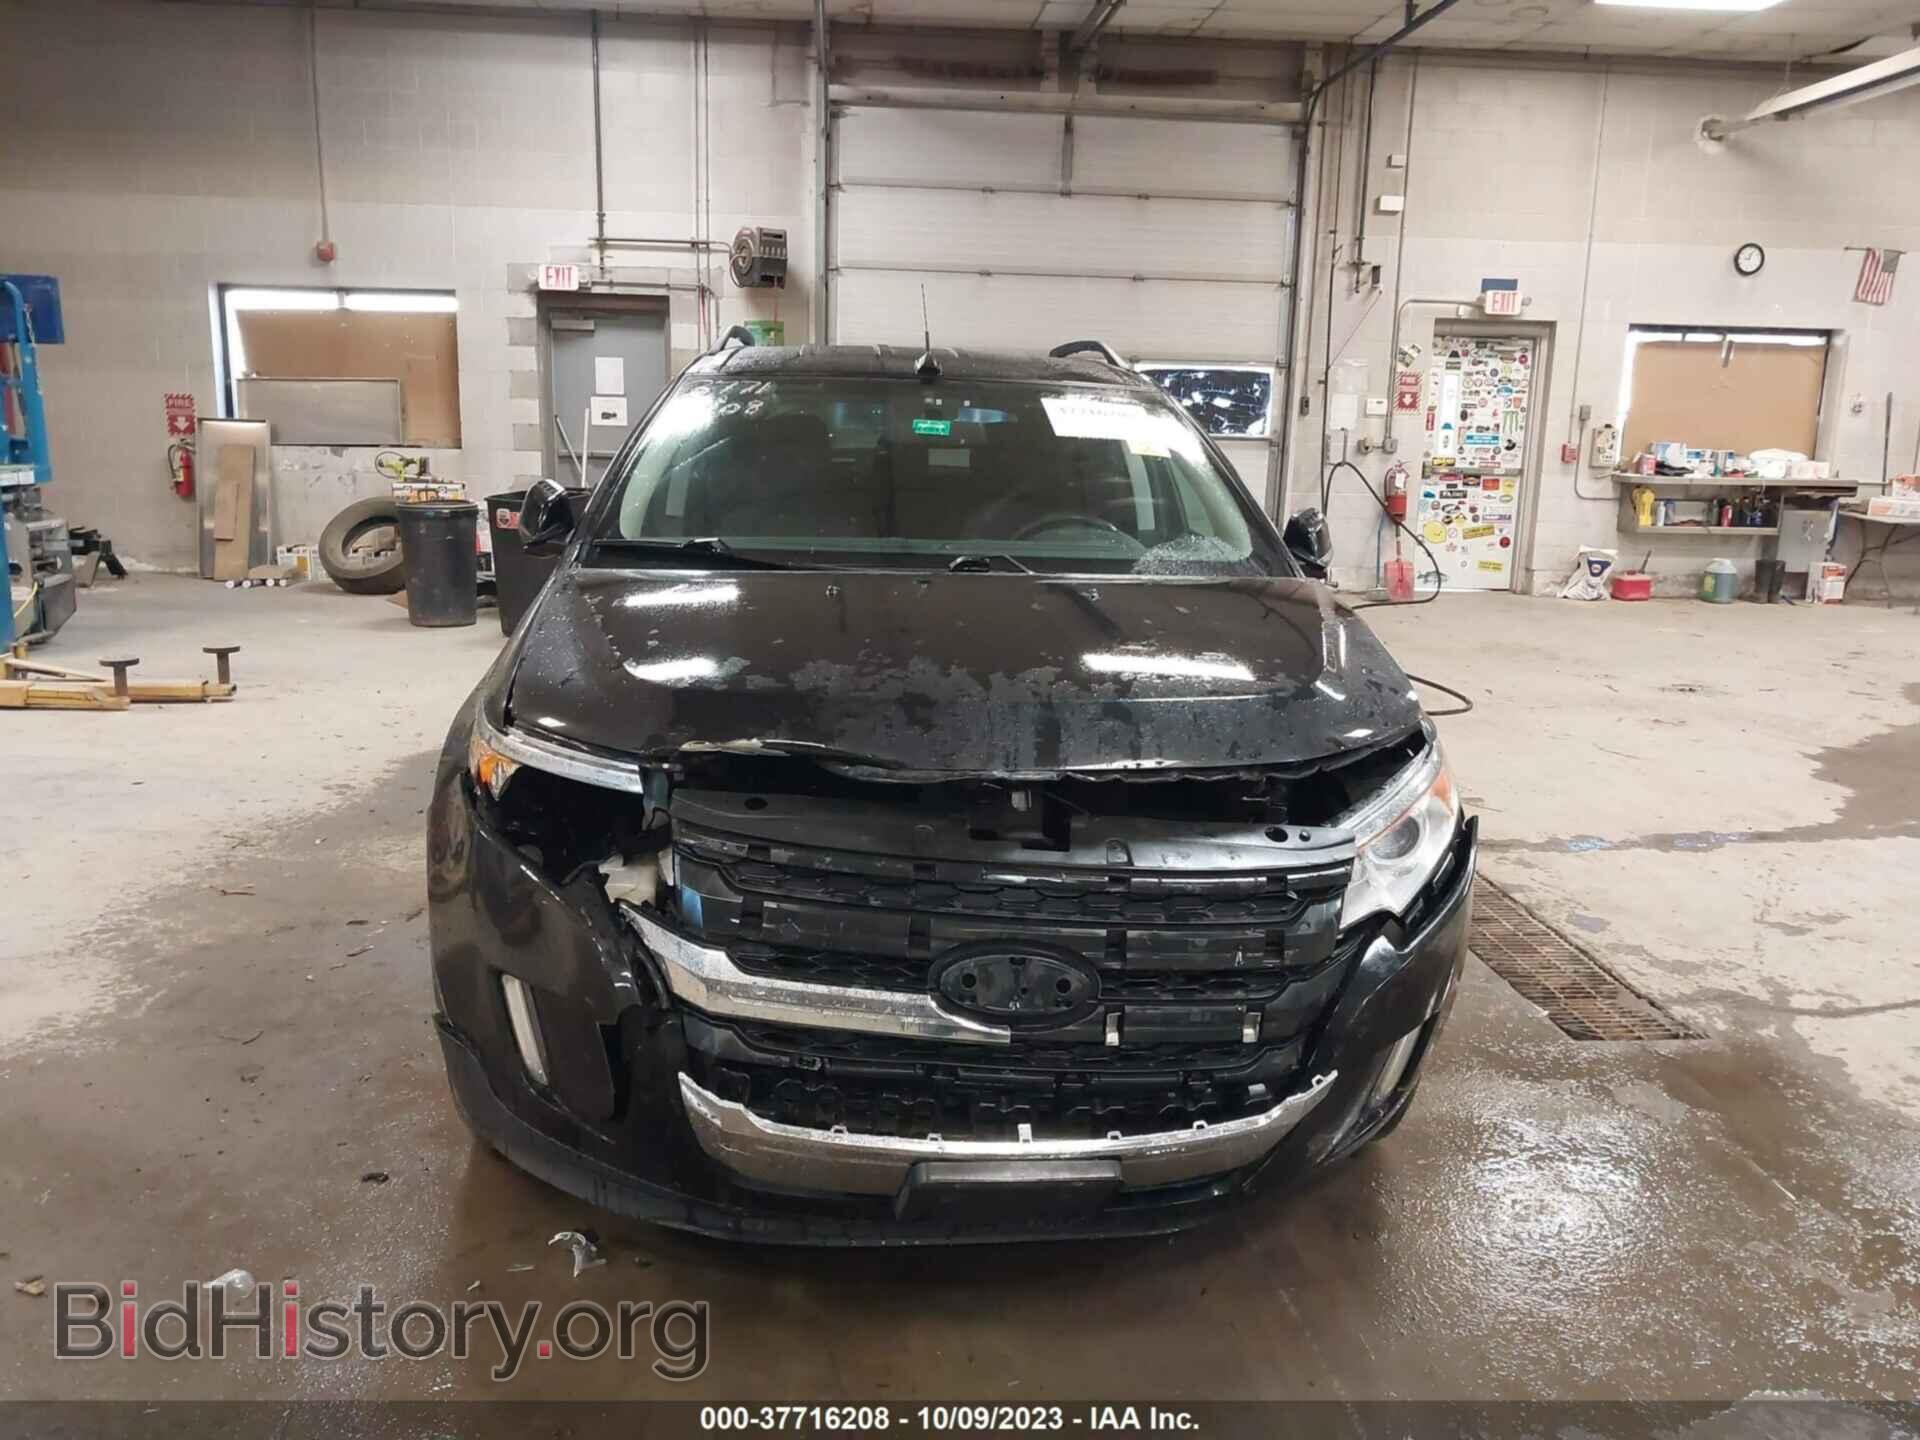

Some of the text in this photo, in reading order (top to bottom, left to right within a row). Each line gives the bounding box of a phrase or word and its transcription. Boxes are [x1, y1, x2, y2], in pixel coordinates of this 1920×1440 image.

[546, 266, 572, 288] EXIT
[1492, 292, 1519, 312] EXIT
[168, 398, 191, 408] FIRE
